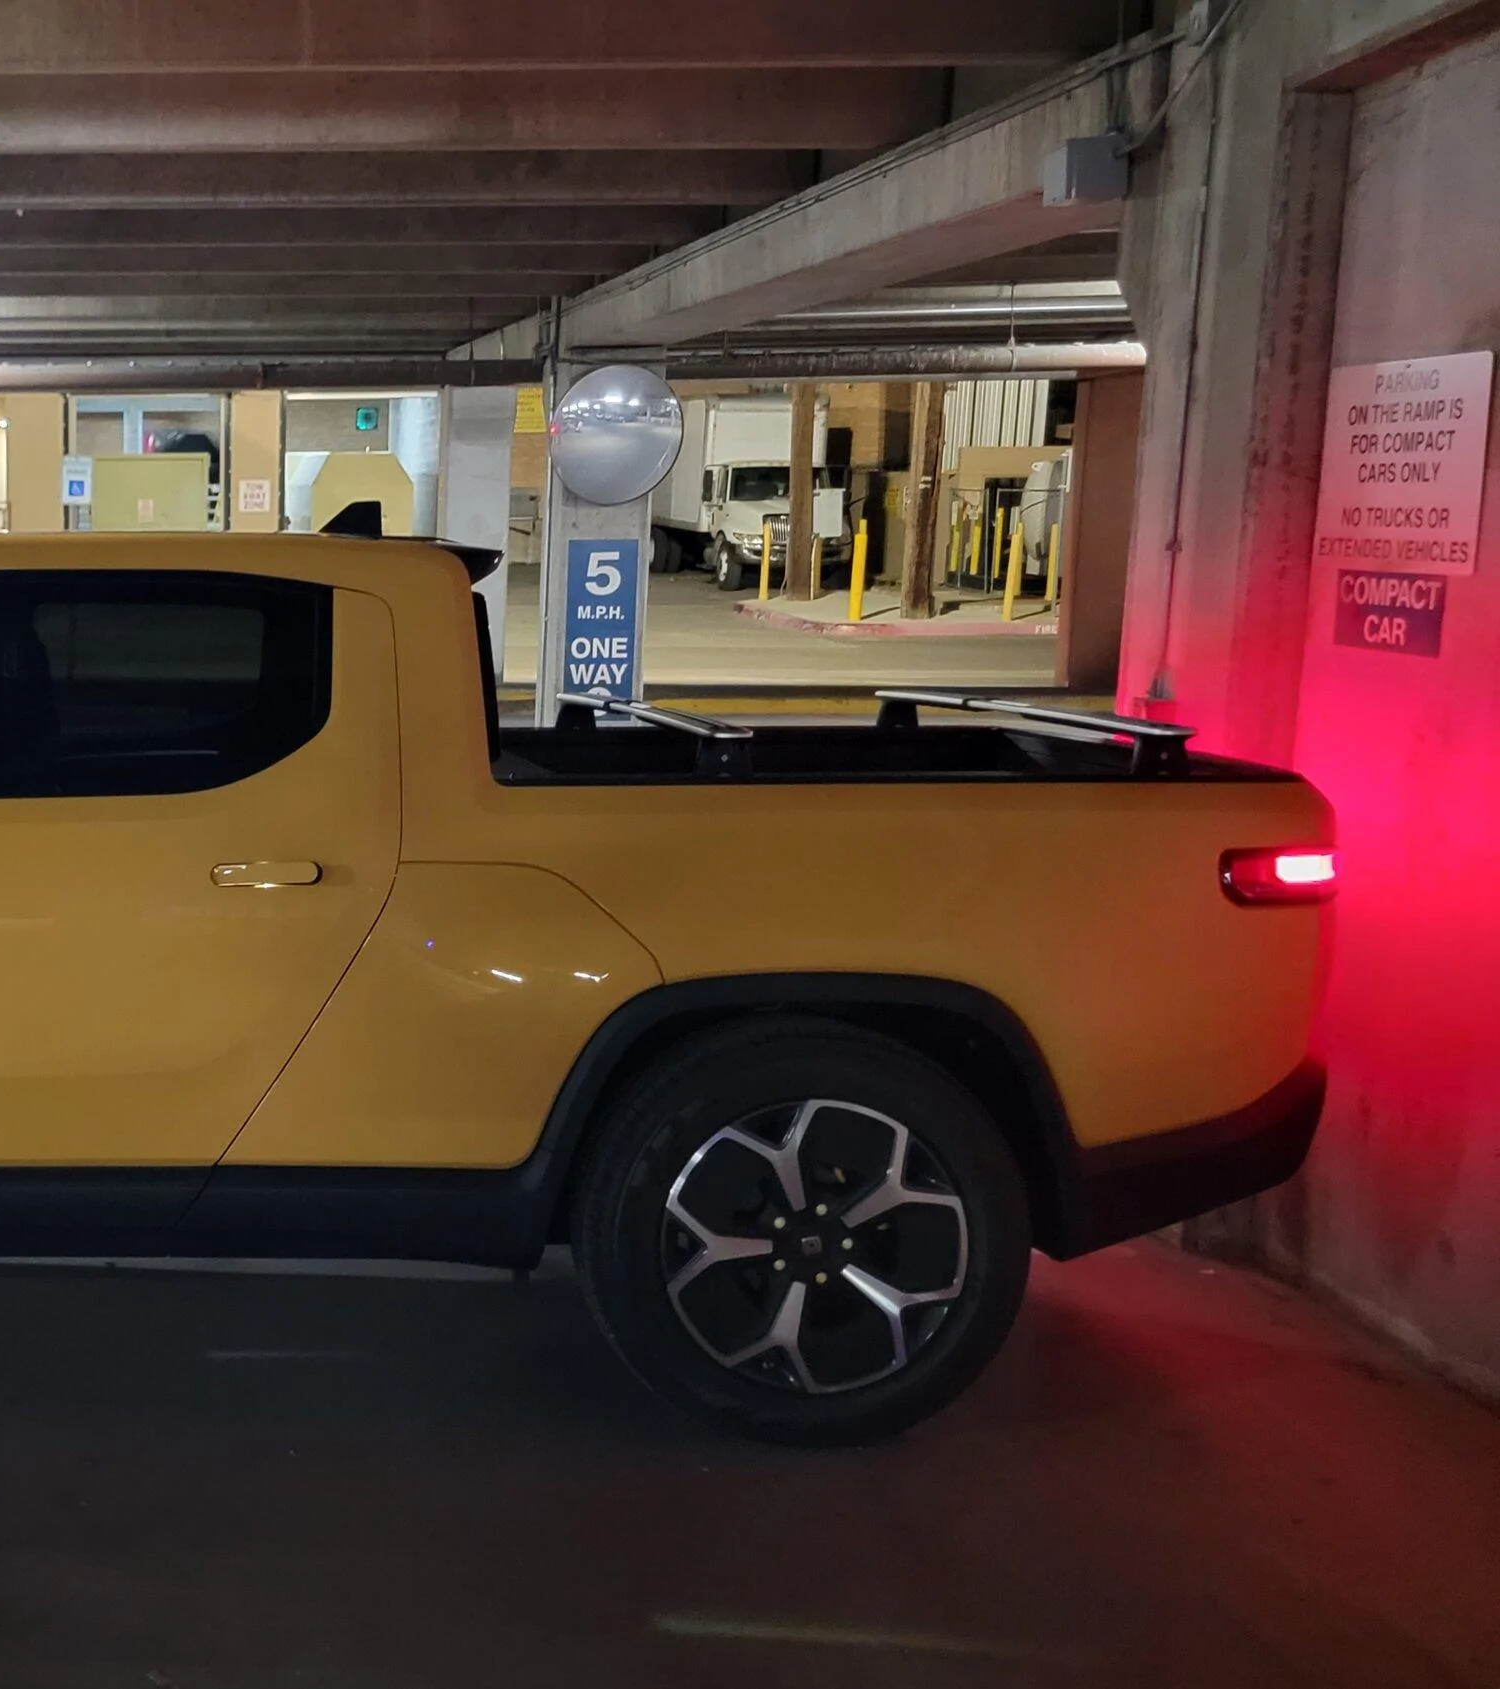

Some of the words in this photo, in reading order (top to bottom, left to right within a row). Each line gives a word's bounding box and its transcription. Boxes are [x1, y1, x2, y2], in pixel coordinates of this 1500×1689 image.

[1374, 369, 1440, 394] PARKING
[1348, 404, 1369, 427] ON
[1372, 402, 1399, 425] THE
[1403, 400, 1445, 422] RAMP
[1449, 398, 1464, 420] IS
[1350, 433, 1379, 456] FOR
[1382, 429, 1456, 454] COMPACT
[1357, 462, 1396, 484] CARS
[1400, 461, 1441, 483] ONLY
[1341, 506, 1361, 528] NO
[1366, 506, 1424, 529] TRUCKS
[1427, 507, 1450, 529] OR
[1317, 537, 1393, 560] EXTENDED
[1396, 540, 1469, 564] VEHICLES
[585, 551, 622, 596] 5
[1340, 575, 1443, 611] COMPACT
[577, 605, 625, 620] M.P.H.
[1363, 614, 1406, 646] CAR
[571, 637, 628, 659] ONE
[570, 663, 628, 685] WAY
